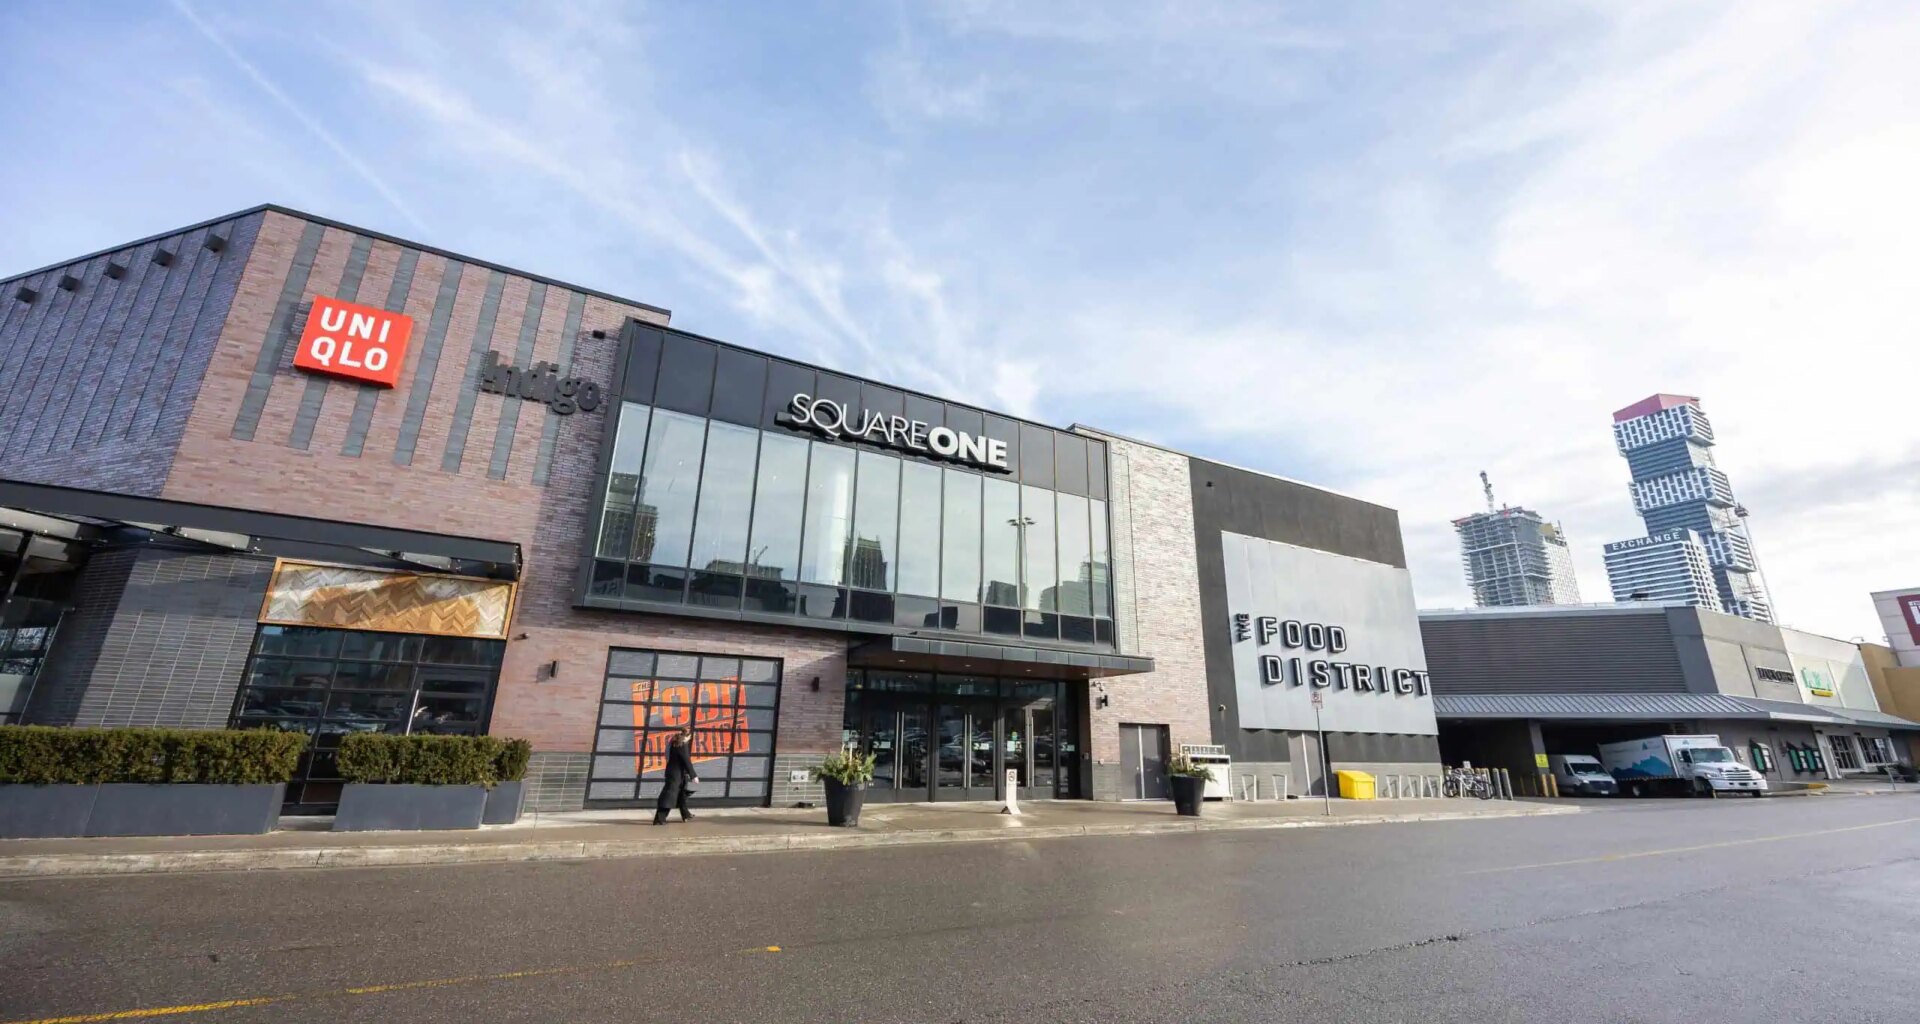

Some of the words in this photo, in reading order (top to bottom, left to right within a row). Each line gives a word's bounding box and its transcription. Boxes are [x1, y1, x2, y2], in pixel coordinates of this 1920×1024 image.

[320, 306, 391, 343] UNI
[310, 336, 388, 371] QLO
[482, 350, 600, 415] Indigo
[1612, 532, 1680, 551] EXCHANGE
[1235, 613, 1252, 643] THE
[1259, 616, 1348, 653] FOOD
[1263, 655, 1429, 696] DISTRICT
[632, 681, 747, 736] FOOD
[637, 719, 747, 770] DIRICT
